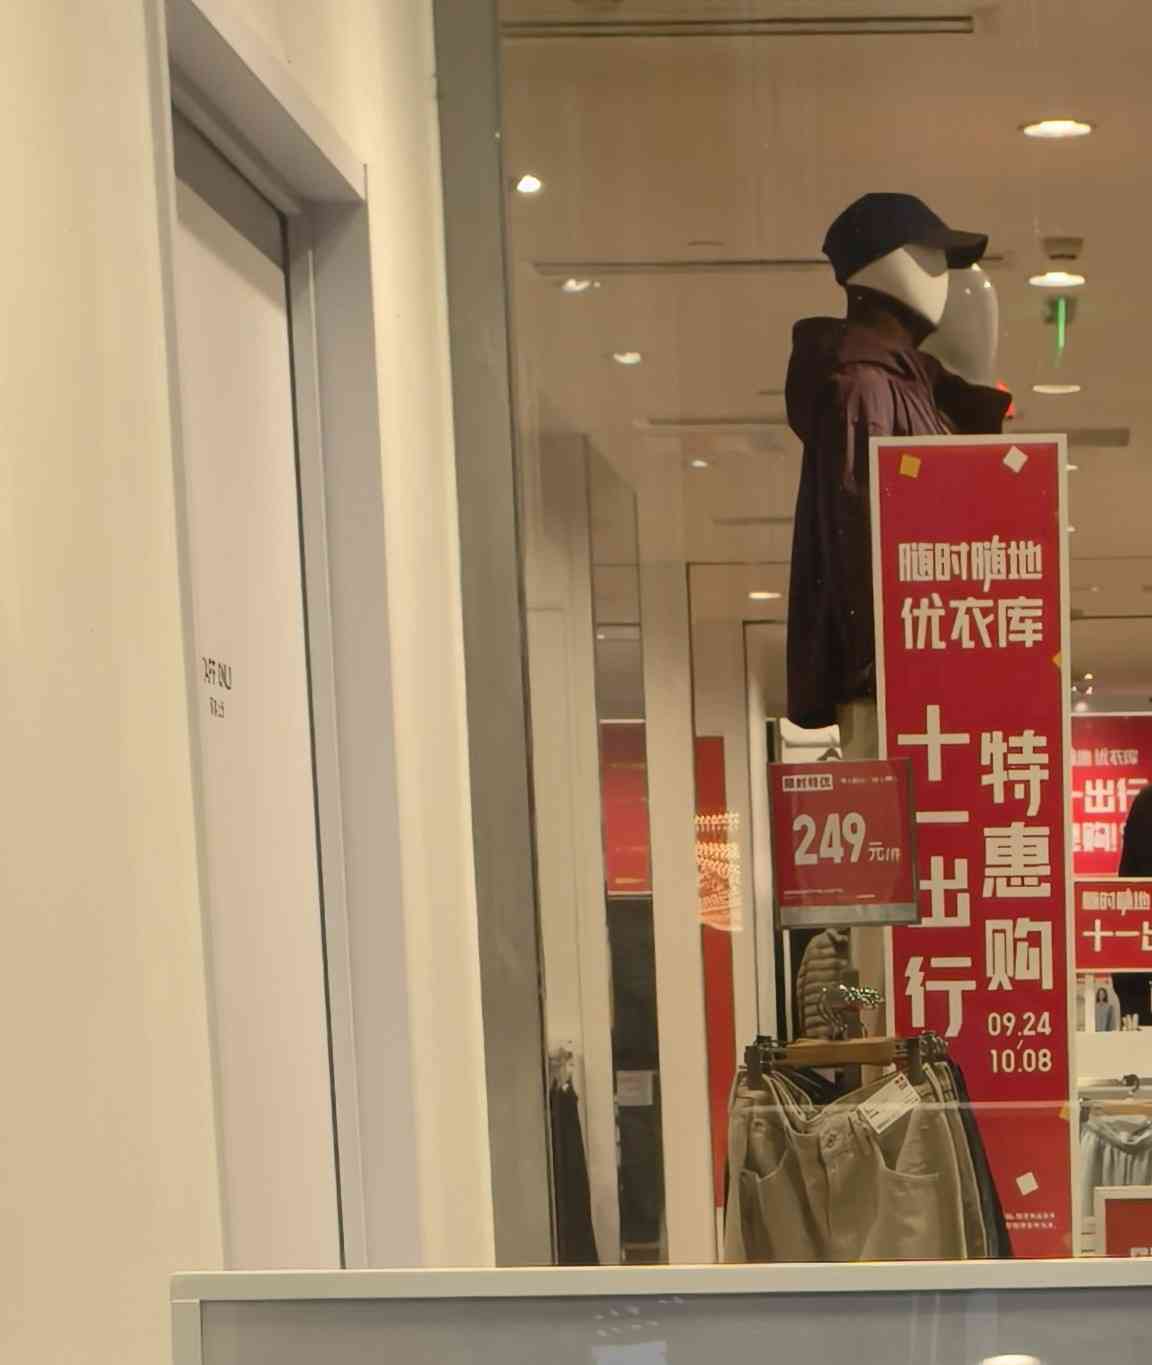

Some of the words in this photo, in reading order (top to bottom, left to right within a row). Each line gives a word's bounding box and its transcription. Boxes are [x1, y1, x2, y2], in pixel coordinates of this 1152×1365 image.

[897, 535, 1043, 591] 随时随地
[900, 596, 1045, 650] 优衣库
[793, 812, 867, 865] 249
[981, 729, 1054, 993] 特惠购
[988, 1011, 1052, 1039] 09.24
[990, 1047, 1052, 1074] 10.08
